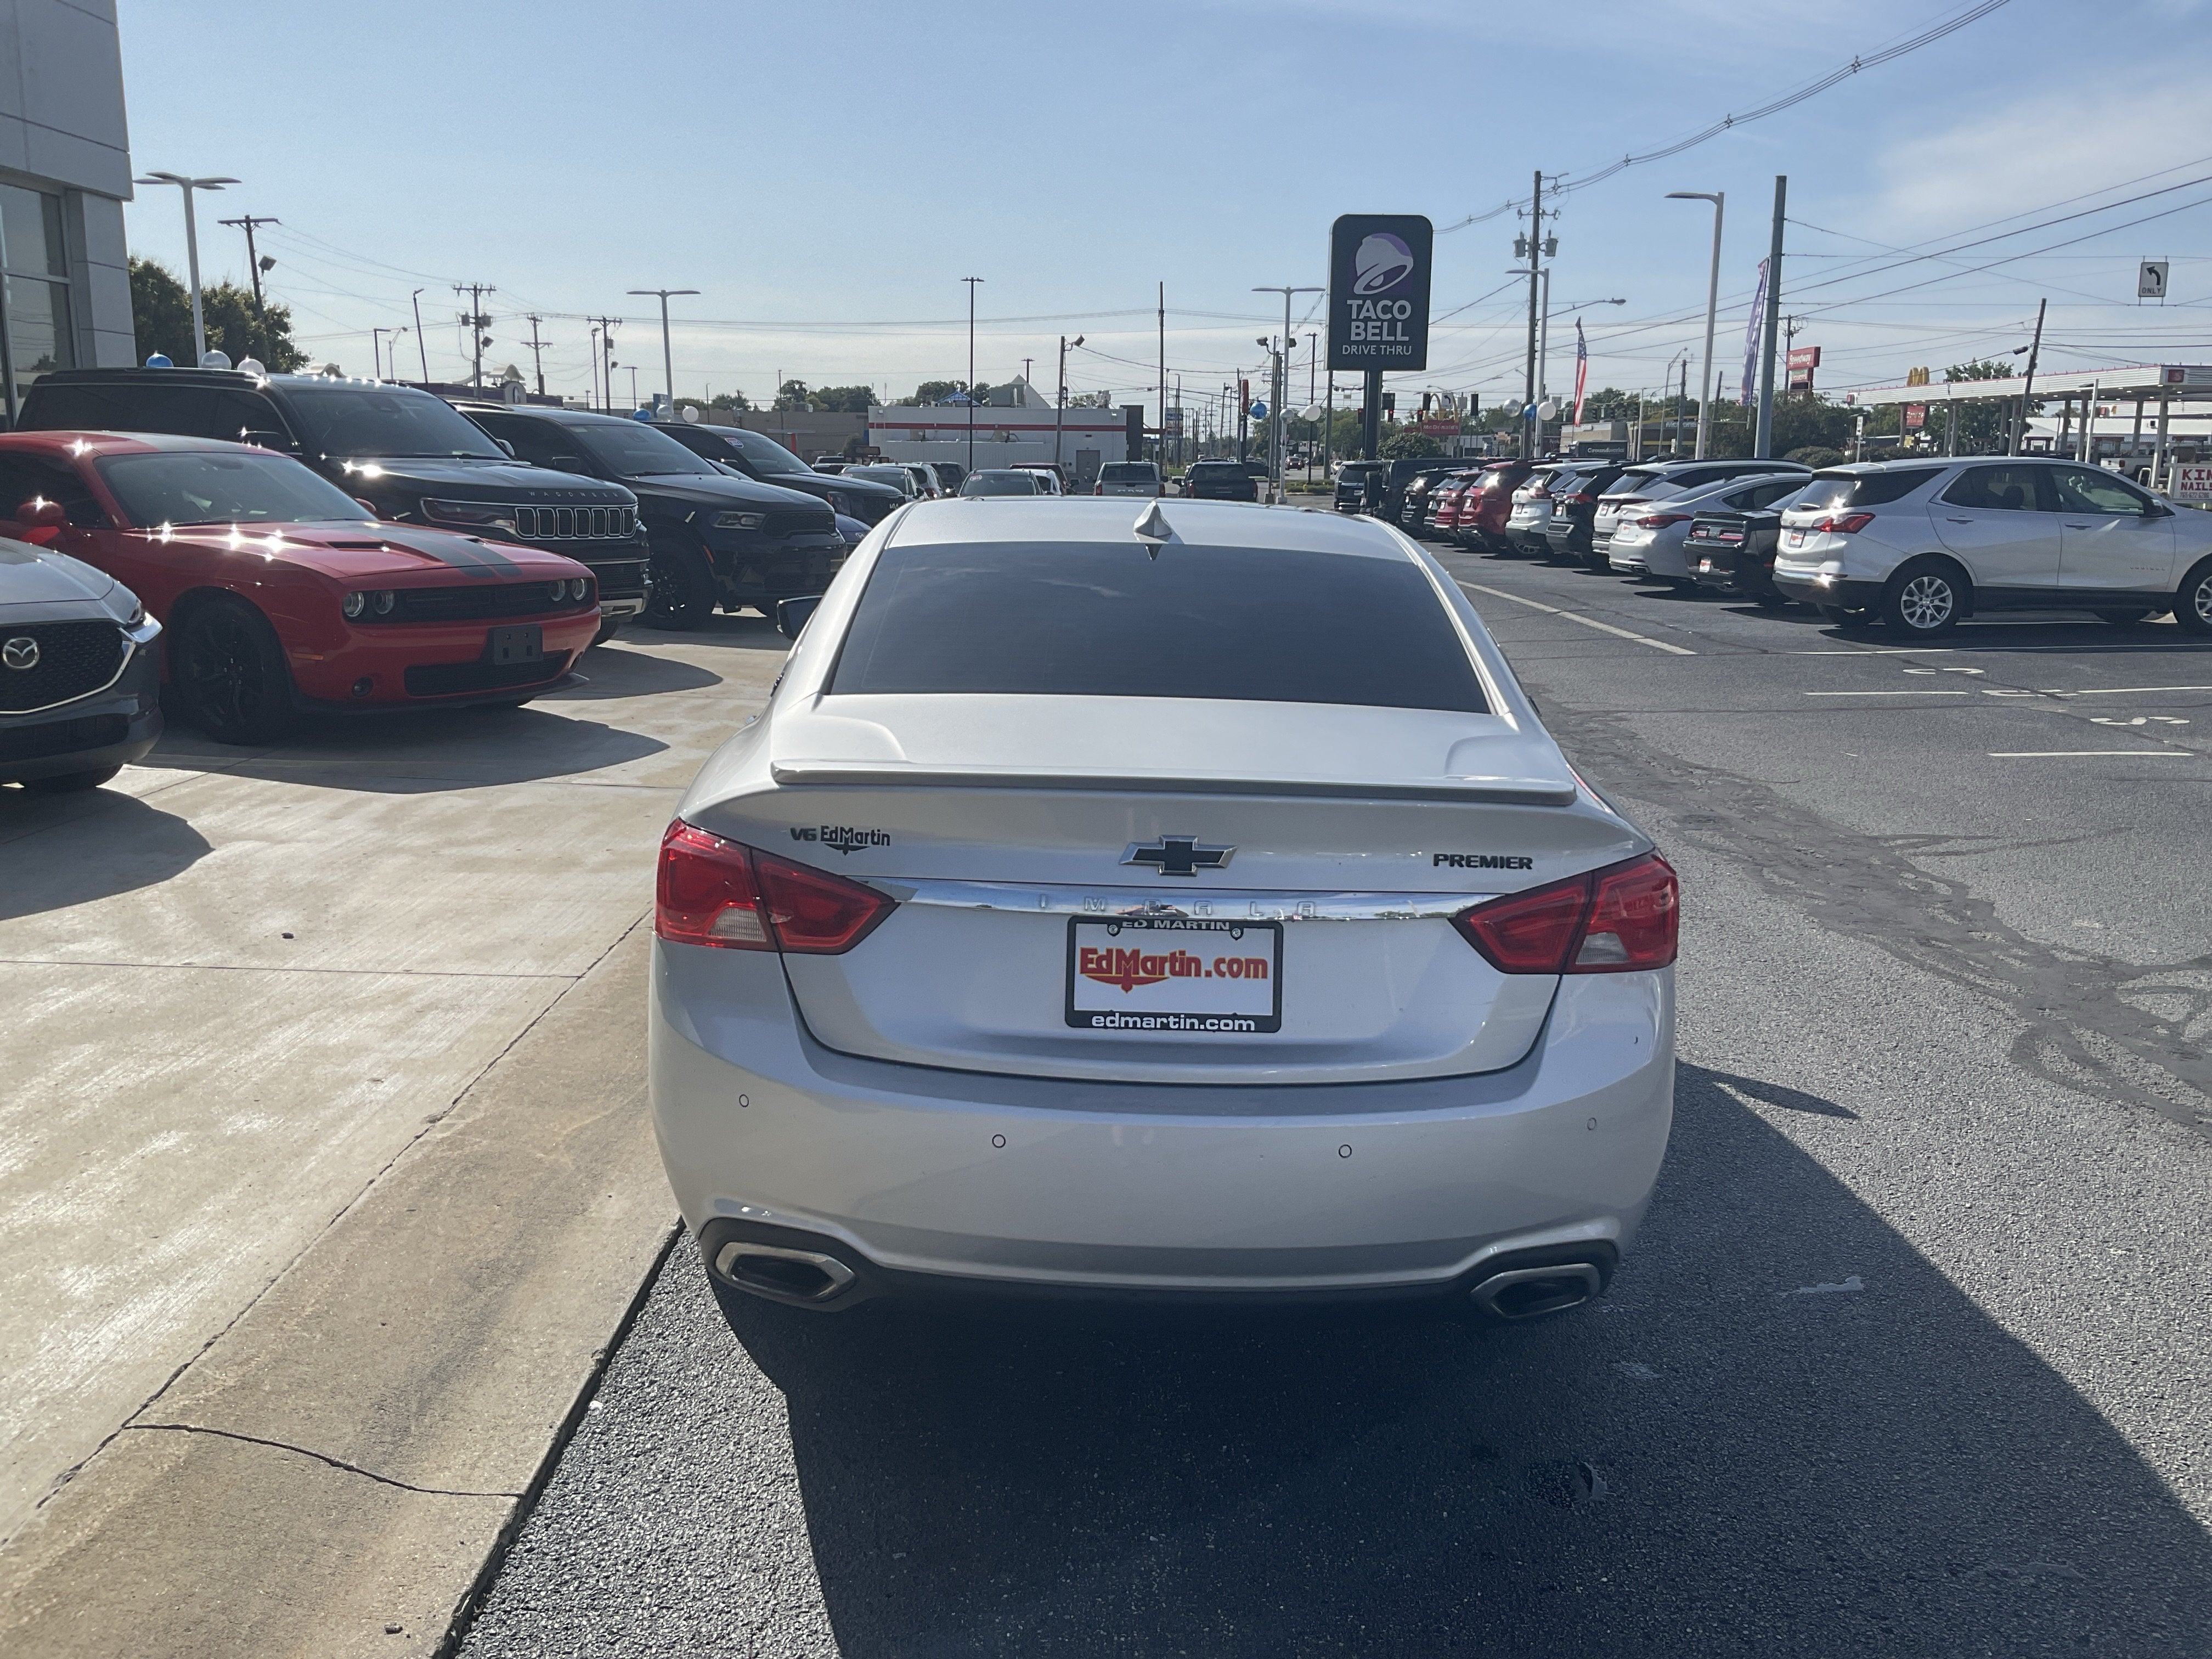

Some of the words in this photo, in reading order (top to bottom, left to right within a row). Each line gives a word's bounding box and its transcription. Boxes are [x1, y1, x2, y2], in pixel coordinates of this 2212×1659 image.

[1347, 300, 1412, 320] TACO
[1350, 321, 1409, 341] BELL
[1342, 345, 1376, 355] DRIVE
[1379, 345, 1412, 355] THRU
[1790, 354, 1811, 367] Speedway
[790, 827, 817, 842] V6
[820, 825, 890, 848] EdMartin
[1433, 853, 1533, 870] PREMIER
[1039, 894, 1316, 917] IMPALA
[1122, 919, 1148, 928] ED
[1154, 920, 1229, 931] MARTIN
[1079, 946, 1268, 982] EdMartin.com
[1091, 1012, 1255, 1032] edmartin.com
